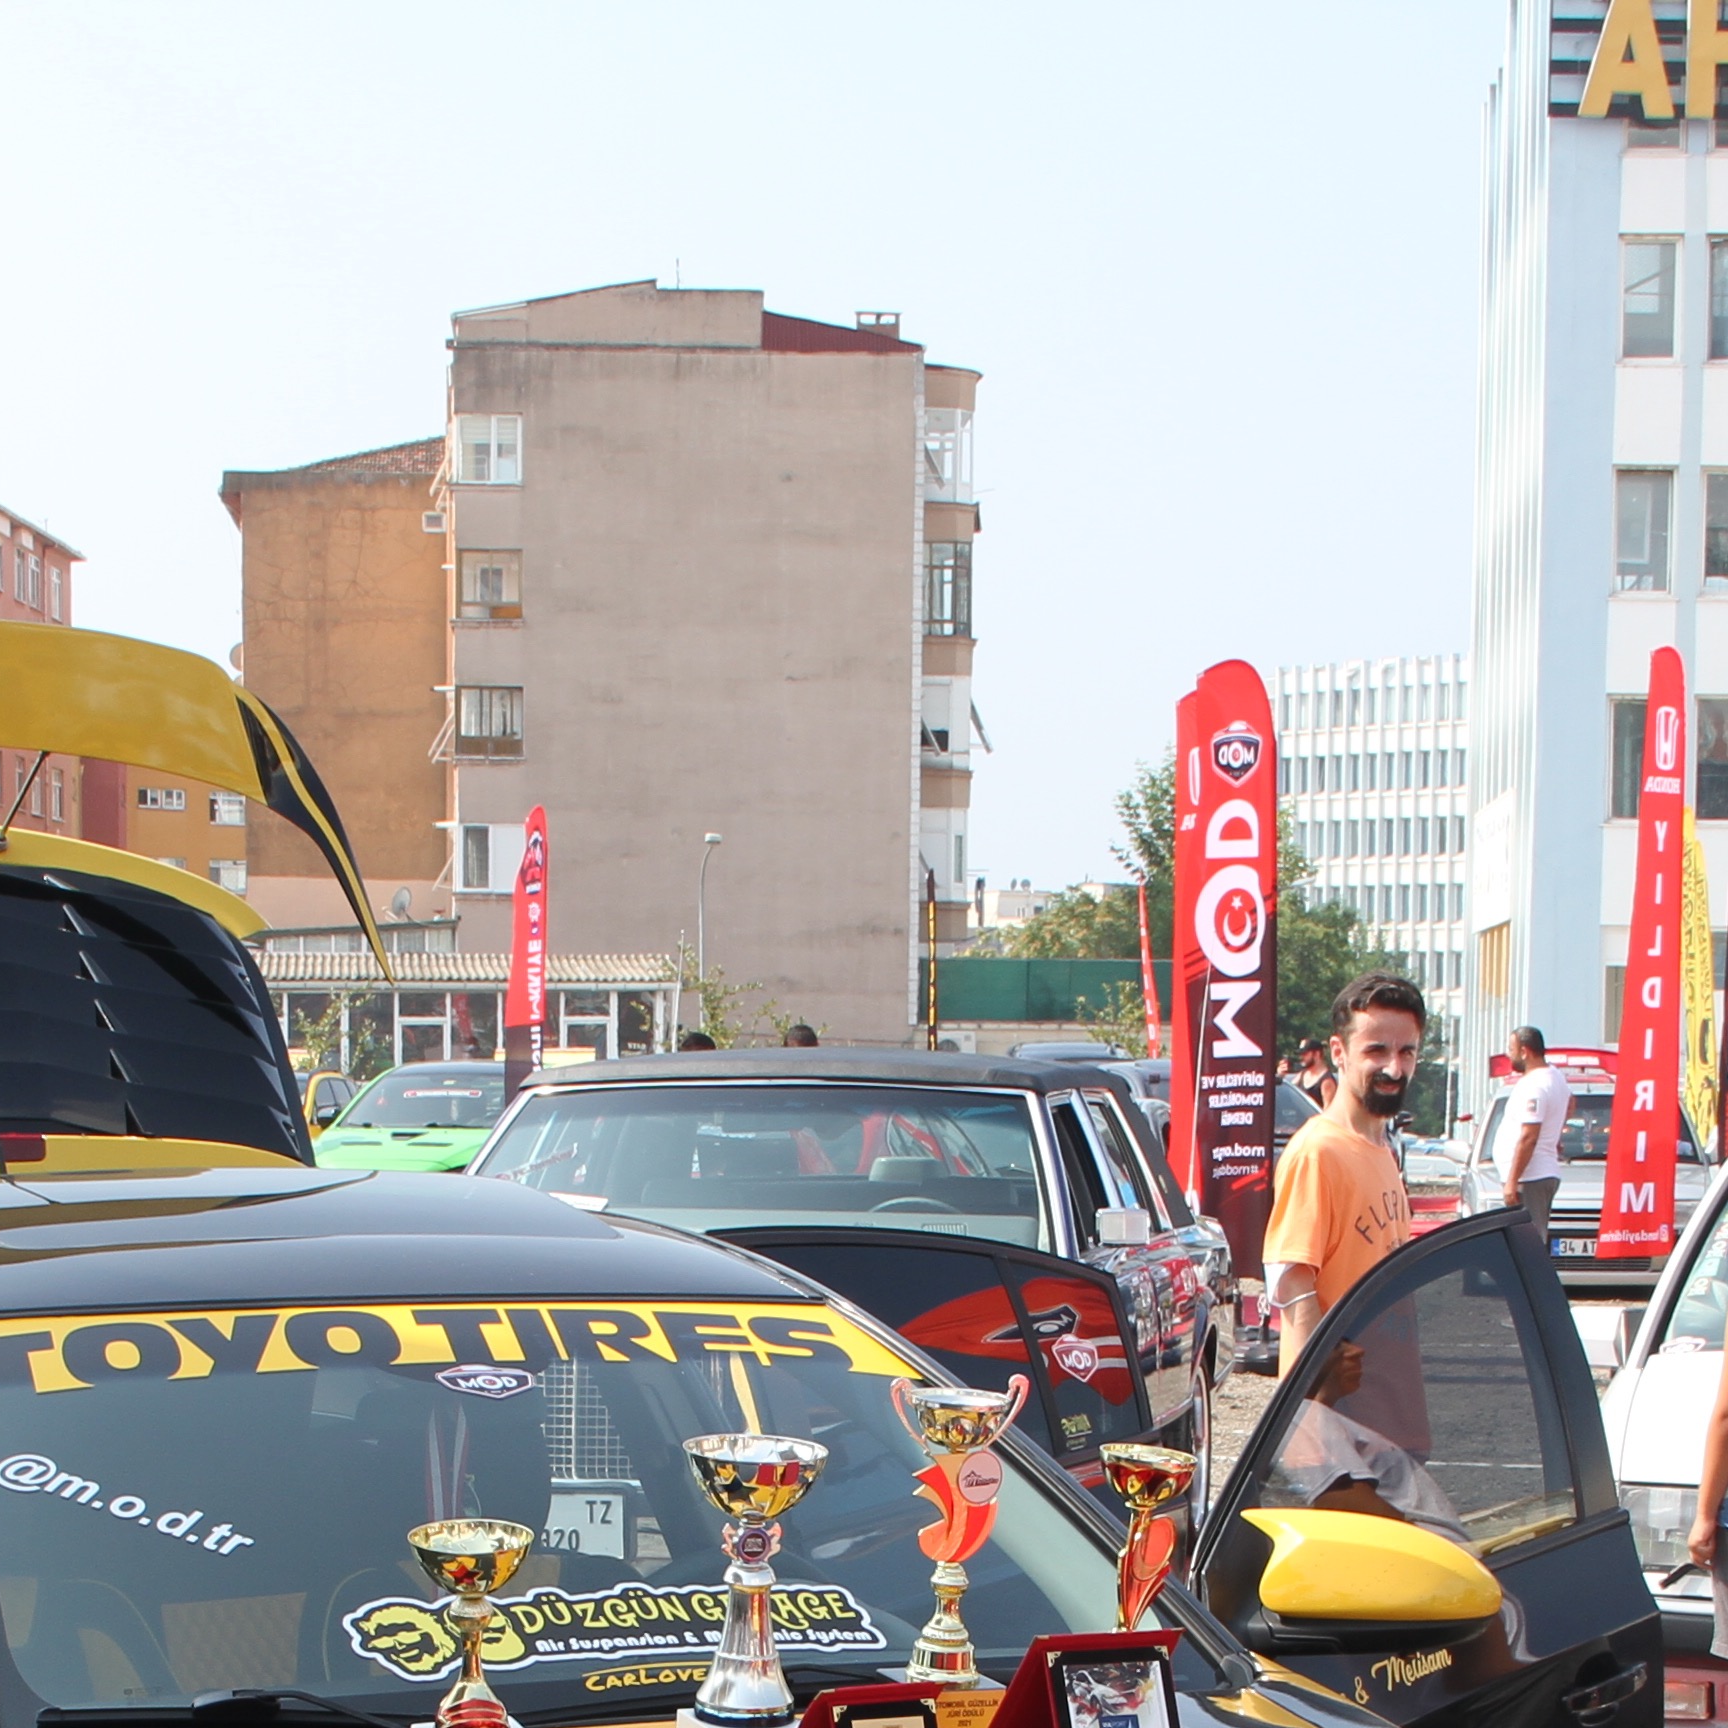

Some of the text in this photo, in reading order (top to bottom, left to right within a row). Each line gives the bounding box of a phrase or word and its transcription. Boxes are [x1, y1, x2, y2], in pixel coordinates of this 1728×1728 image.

[411, 1308, 854, 1371] TIRES
[1062, 1349, 1092, 1370] MOD
[457, 1374, 517, 1390] MOD
[585, 1500, 614, 1525] TZ
[510, 1588, 857, 1634] DÜZGÜN GAGE
[535, 1639, 566, 1654] Air
[685, 1631, 701, 1645] &
[806, 1627, 873, 1644] System
[1354, 1675, 1370, 1705] &
